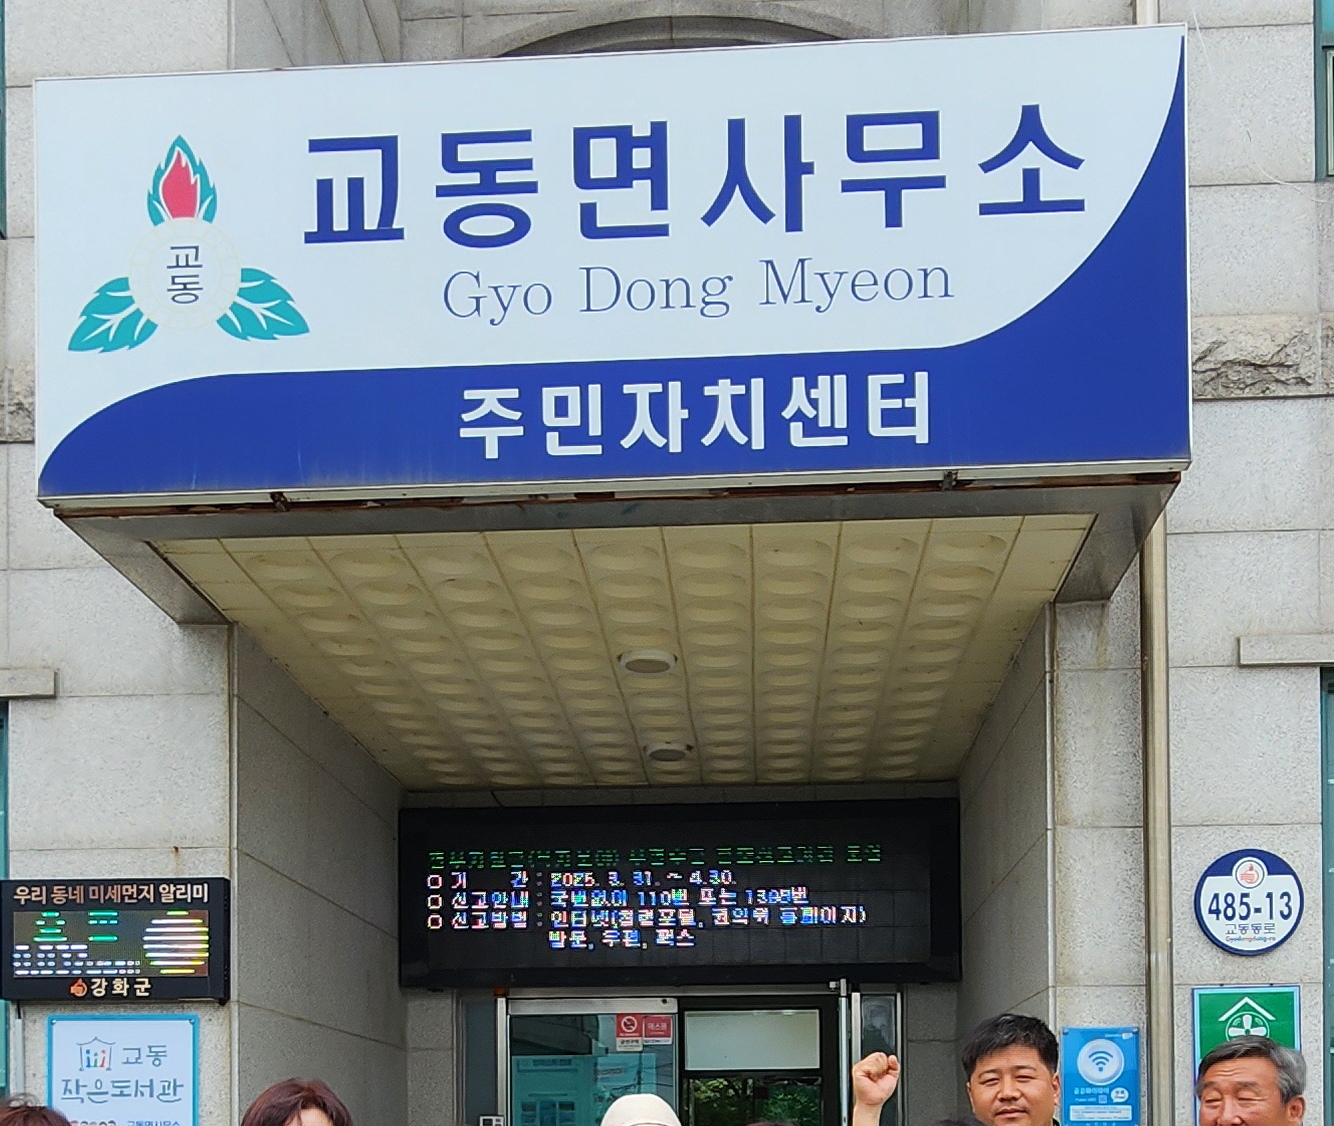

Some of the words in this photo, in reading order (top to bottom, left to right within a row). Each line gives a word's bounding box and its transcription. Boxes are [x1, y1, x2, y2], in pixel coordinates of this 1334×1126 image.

[302, 102, 1088, 249] 교동면사무소
[443, 266, 553, 326] Gyo
[579, 264, 734, 319] Dong
[759, 255, 954, 316] Myeon
[458, 370, 933, 460] 주민자치센터
[13, 884, 47, 905] 우리
[50, 884, 84, 904] 동네
[88, 883, 154, 904] 미세먼지
[158, 882, 208, 903] 알리미
[451, 890, 530, 909] 신고안내
[1208, 891, 1293, 921] 485-13
[451, 911, 528, 930] 신고방법
[1225, 922, 1276, 935] 교동동로
[121, 1044, 167, 1067] 교동
[60, 1078, 185, 1104] 작은도서관
